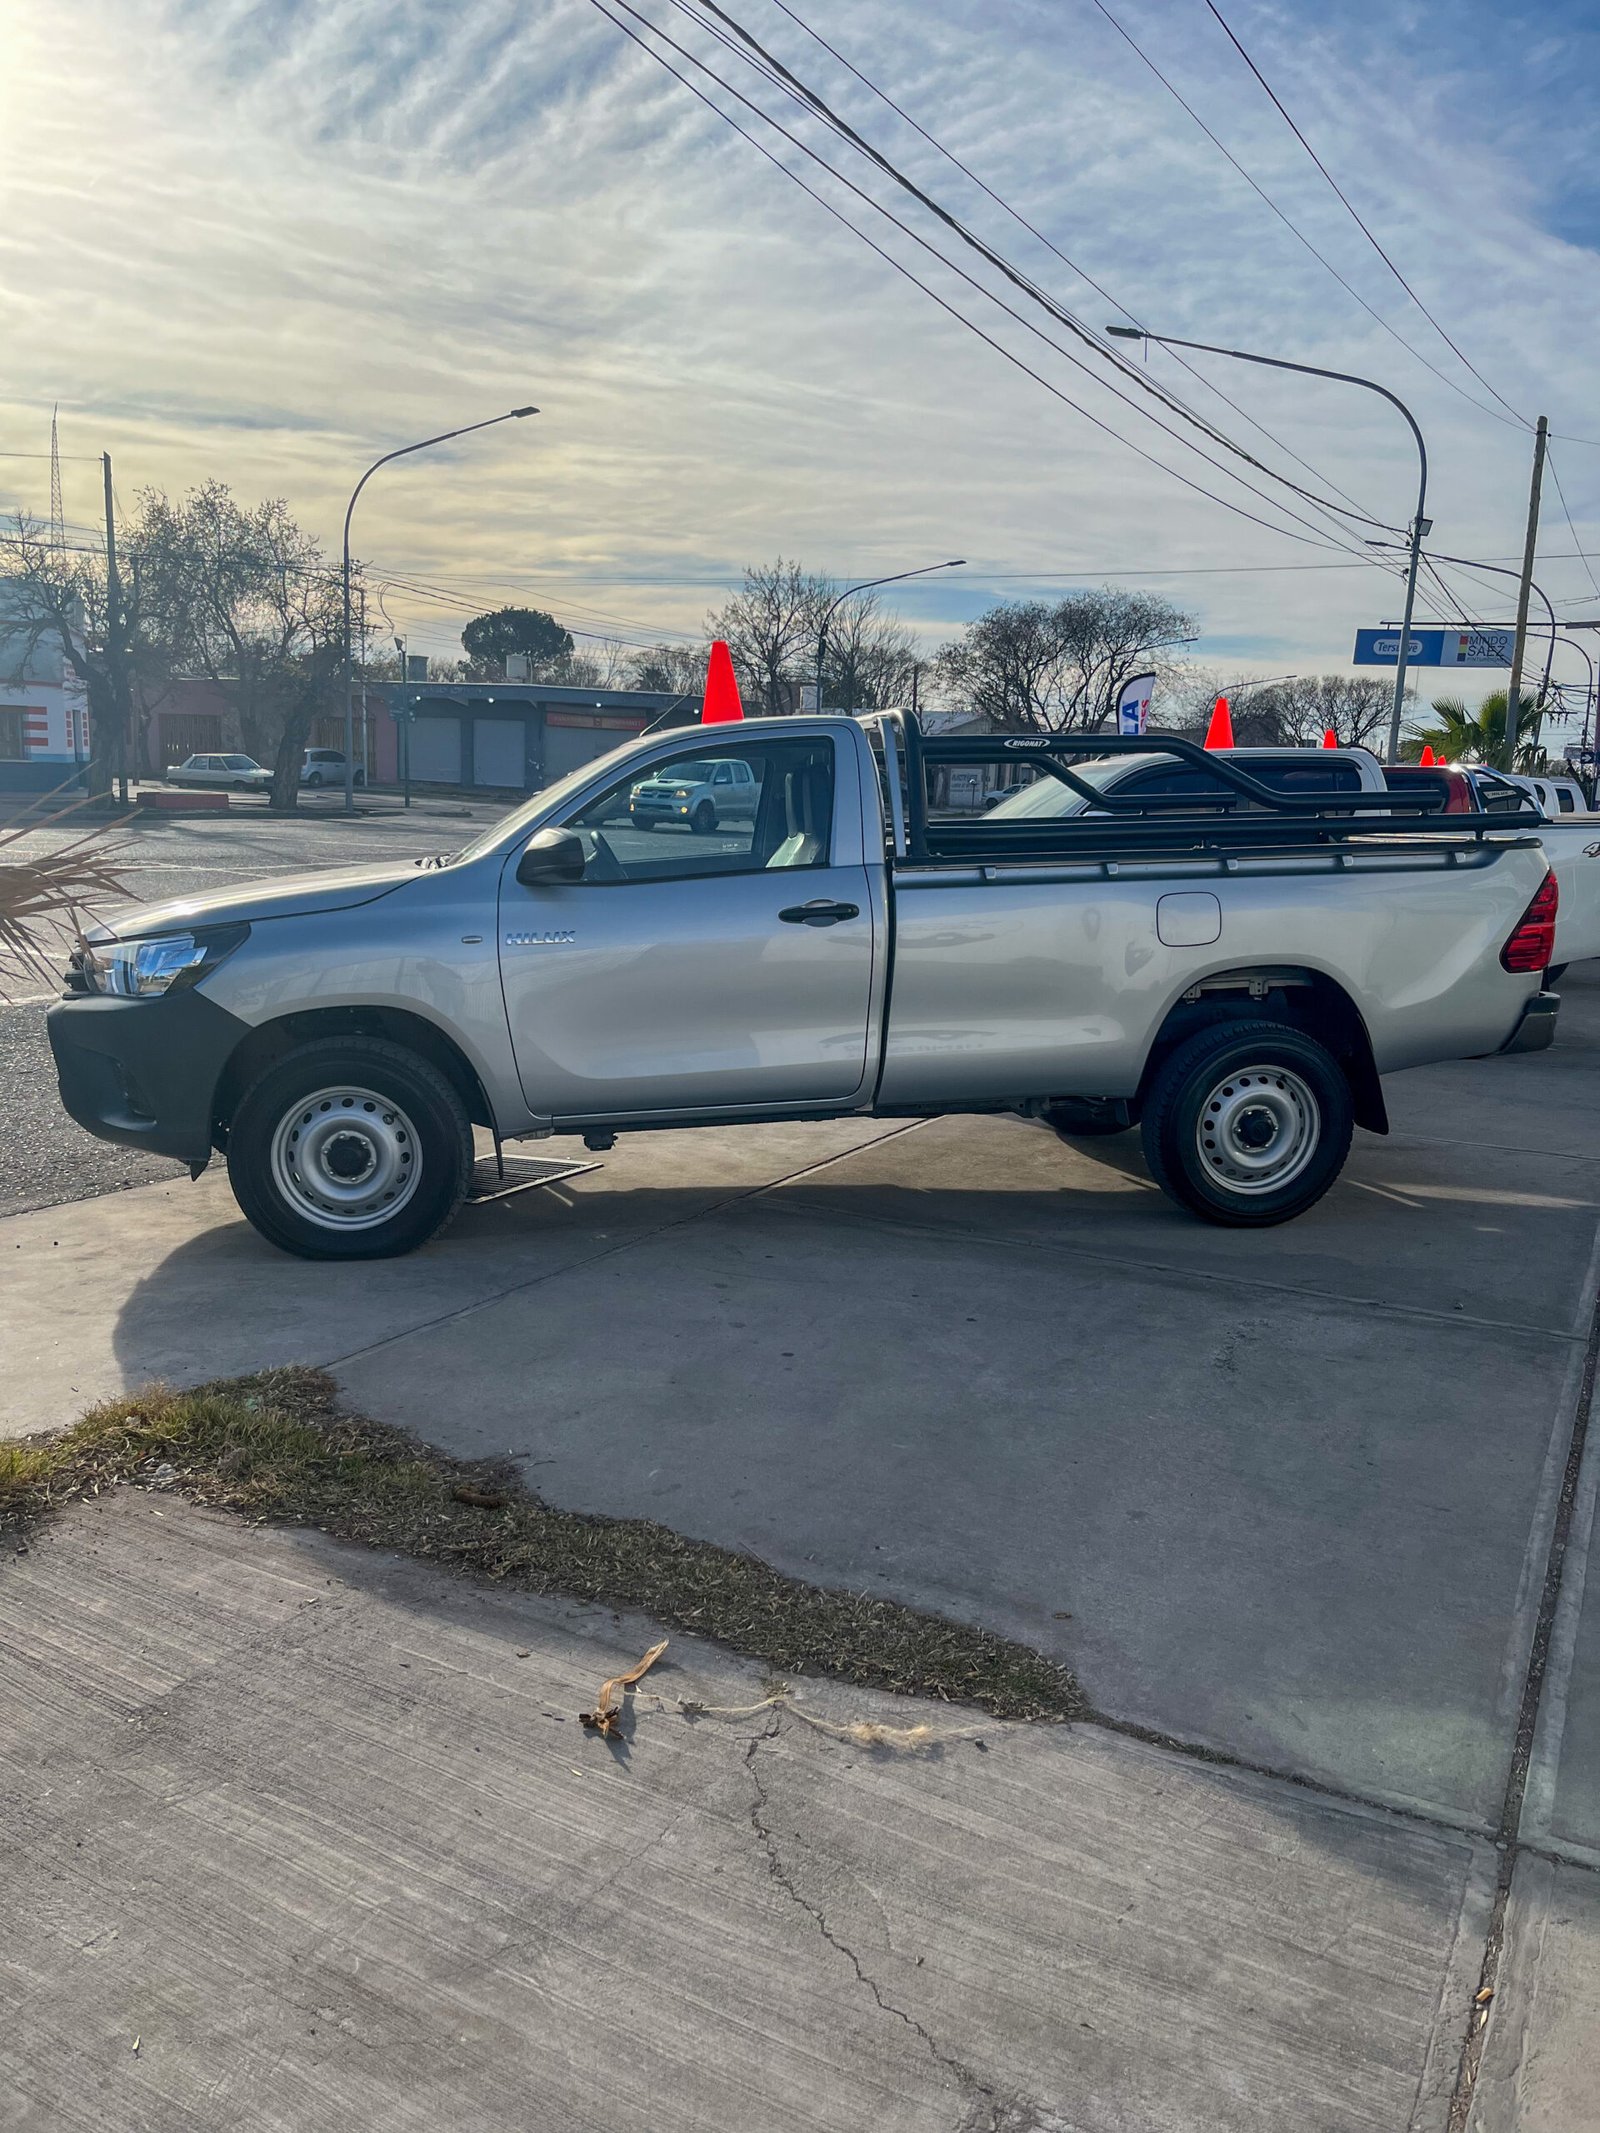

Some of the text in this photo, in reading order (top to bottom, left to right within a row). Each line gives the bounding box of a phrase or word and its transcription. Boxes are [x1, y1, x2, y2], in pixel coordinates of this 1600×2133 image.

[1469, 635, 1508, 645] MINDO
[1377, 641, 1418, 653] Tersuve
[1467, 645, 1505, 657] SAEZ
[506, 930, 576, 945] HILUX
